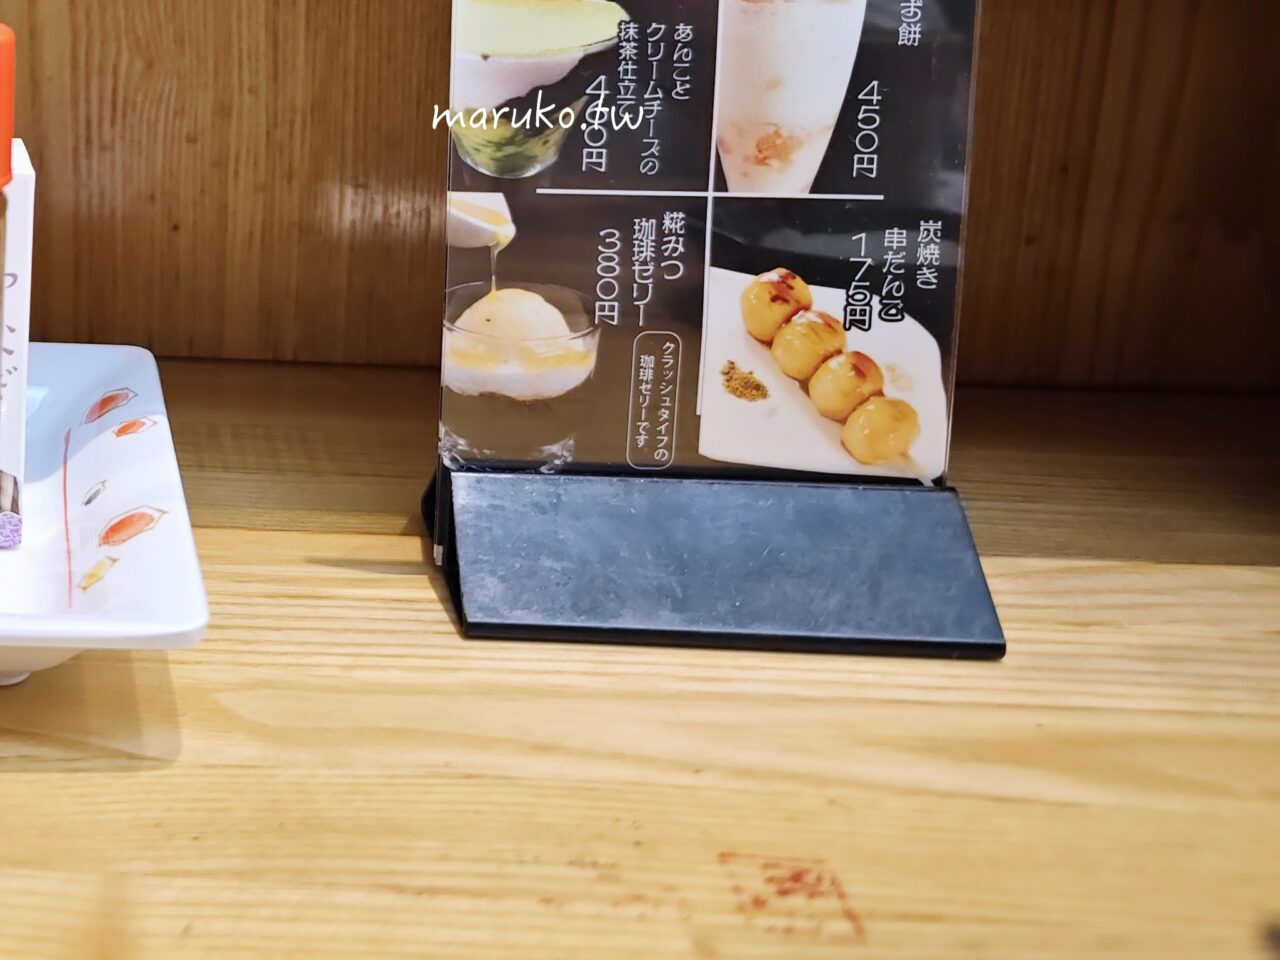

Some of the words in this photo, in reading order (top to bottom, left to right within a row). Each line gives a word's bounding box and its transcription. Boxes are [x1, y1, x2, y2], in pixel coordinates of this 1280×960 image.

[616, 22, 640, 119] 抹茶仕立て
[639, 22, 666, 176] クリームチーズの
[671, 22, 694, 100] あんこと
[852, 80, 883, 179] 450円
[594, 228, 621, 326] 380円
[631, 218, 657, 327] 珈琲ゼリー
[660, 211, 686, 280] 糀みつ
[844, 232, 873, 330] 175円
[881, 227, 907, 320] 串だんご
[915, 220, 942, 289] 炭焼き
